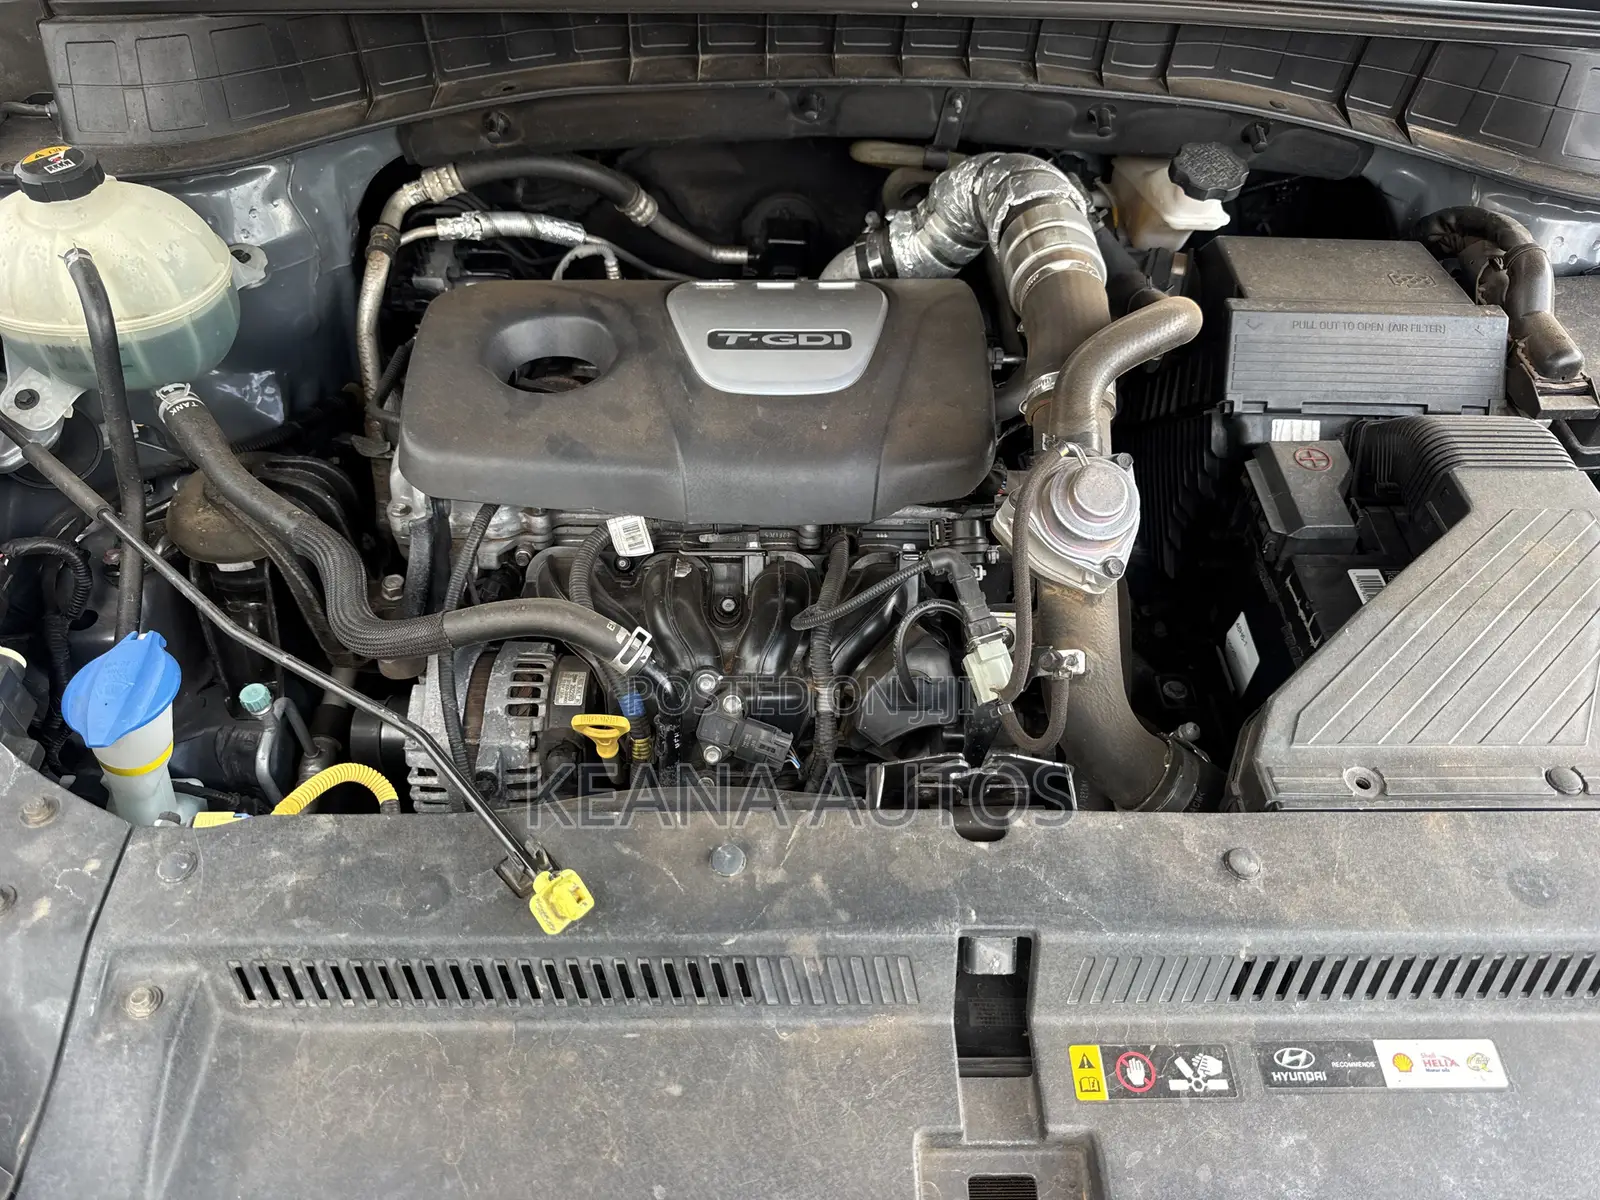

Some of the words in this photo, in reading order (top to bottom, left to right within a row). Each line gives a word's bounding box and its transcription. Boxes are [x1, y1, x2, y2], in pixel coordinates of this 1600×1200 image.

[1292, 320, 1316, 330] PULL
[1319, 321, 1339, 330] OUT
[1342, 321, 1355, 331] TO
[1357, 322, 1384, 332] OPEN
[717, 333, 843, 346] T-GDI
[169, 401, 199, 417] TANK
[1271, 1071, 1327, 1081] HYUNDAI
